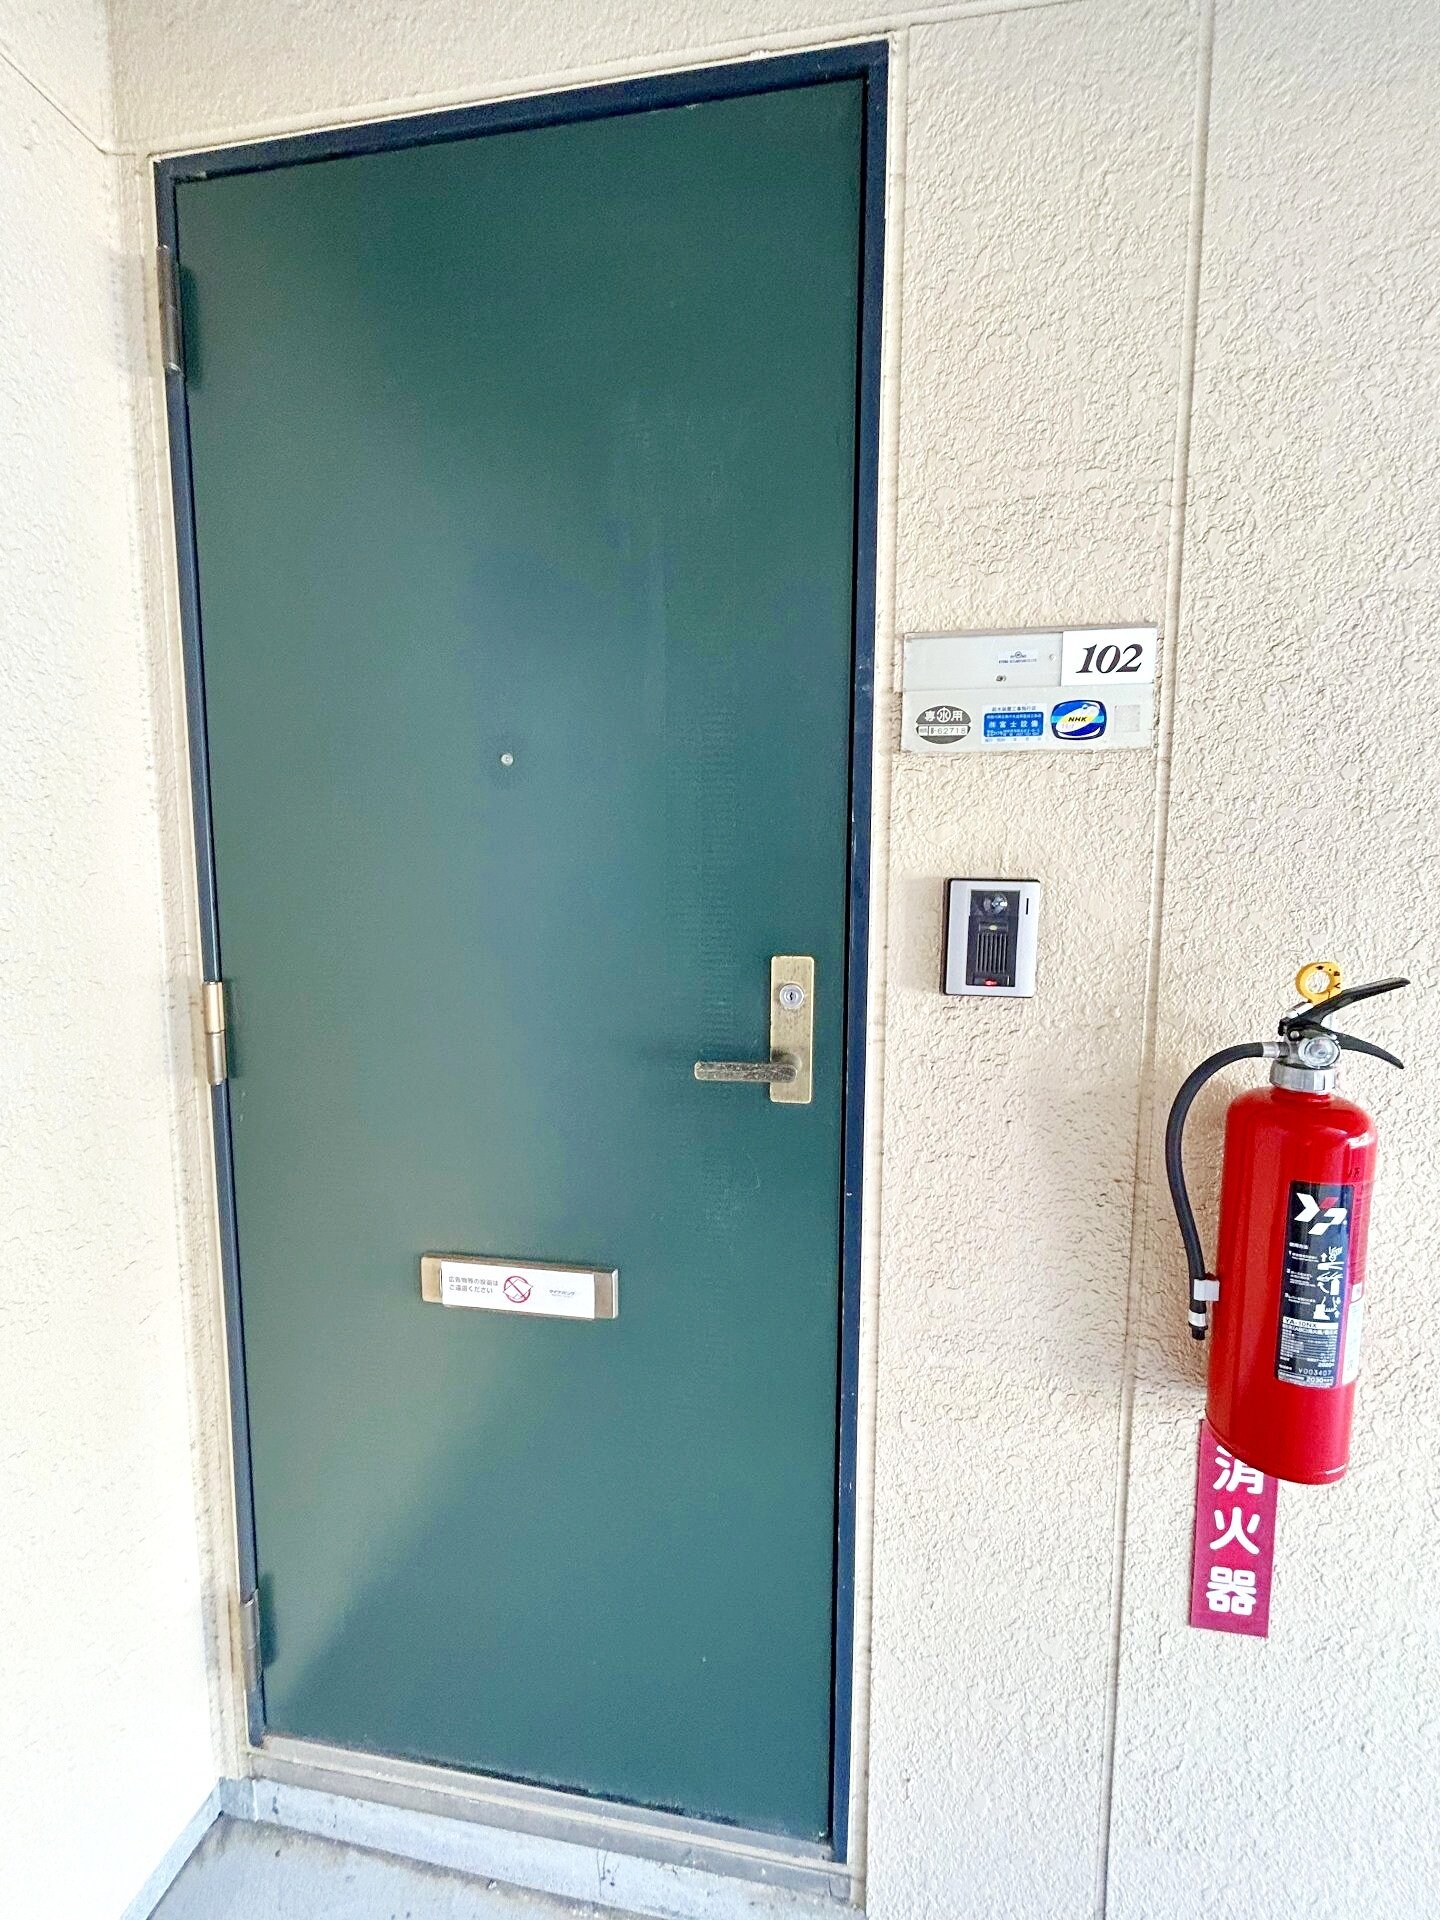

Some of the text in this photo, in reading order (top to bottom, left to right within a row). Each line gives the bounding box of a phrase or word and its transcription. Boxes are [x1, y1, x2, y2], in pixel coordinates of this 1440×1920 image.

[1075, 644, 1143, 674] 102
[1205, 1445, 1265, 1616] 消火器
